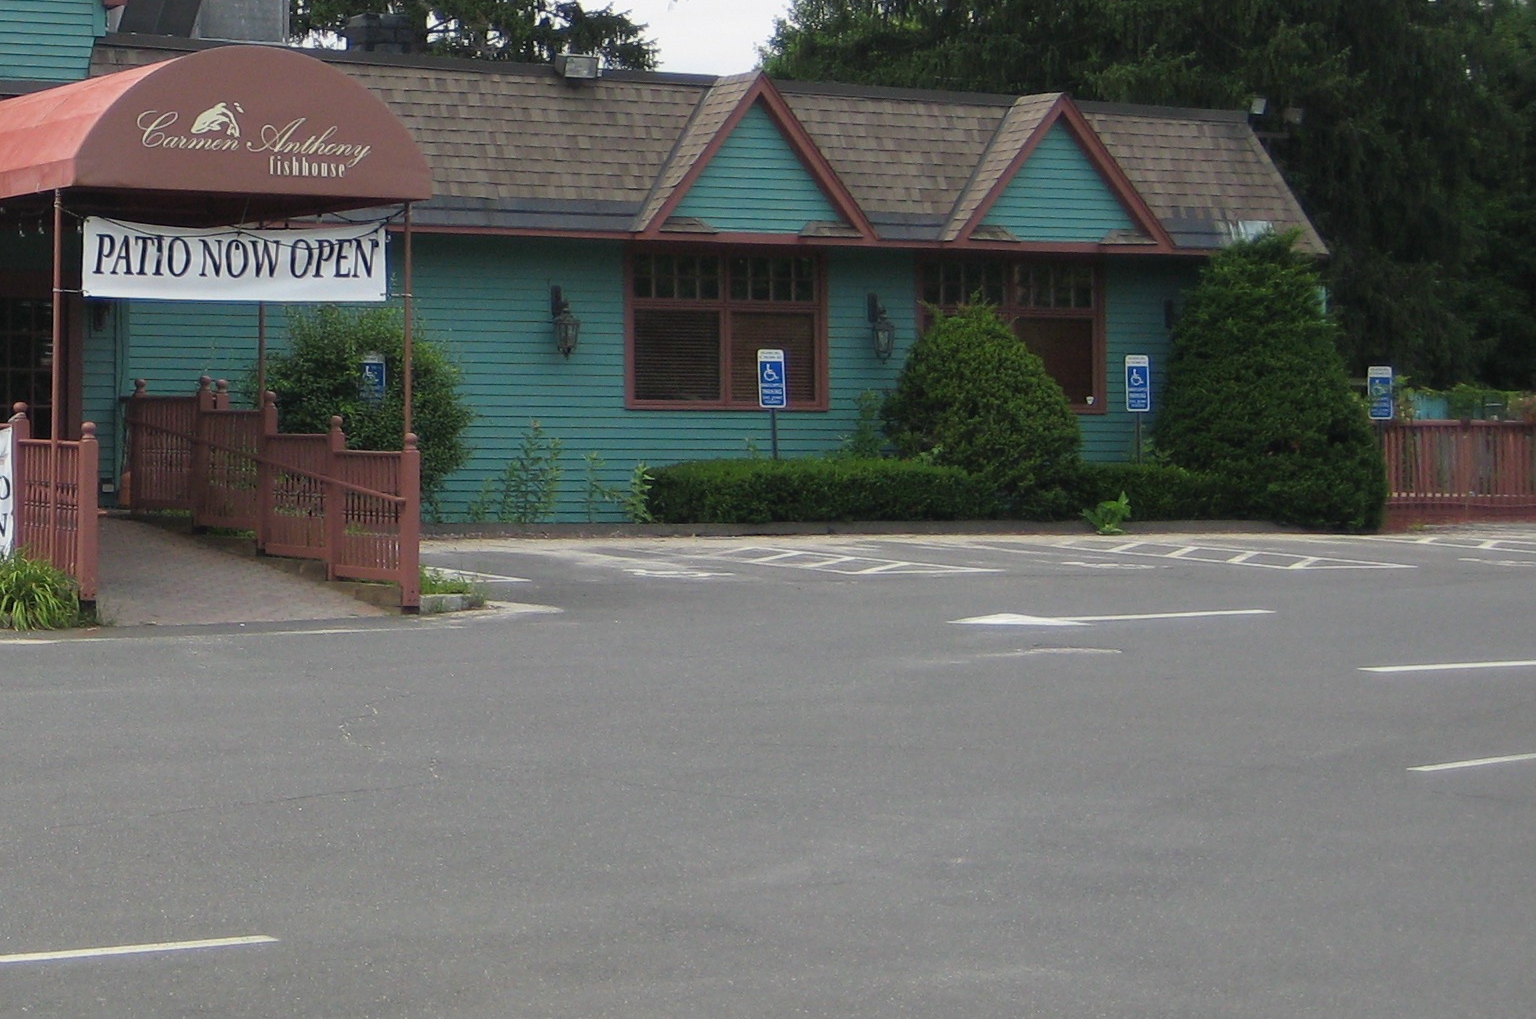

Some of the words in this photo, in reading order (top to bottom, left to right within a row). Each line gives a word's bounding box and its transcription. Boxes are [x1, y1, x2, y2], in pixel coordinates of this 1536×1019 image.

[136, 109, 240, 151] Carmen
[246, 116, 372, 168] Anthony
[269, 155, 346, 178] fishhouse
[92, 232, 192, 279] PATIO
[197, 237, 282, 279] NOW
[290, 238, 379, 279] OPEN
